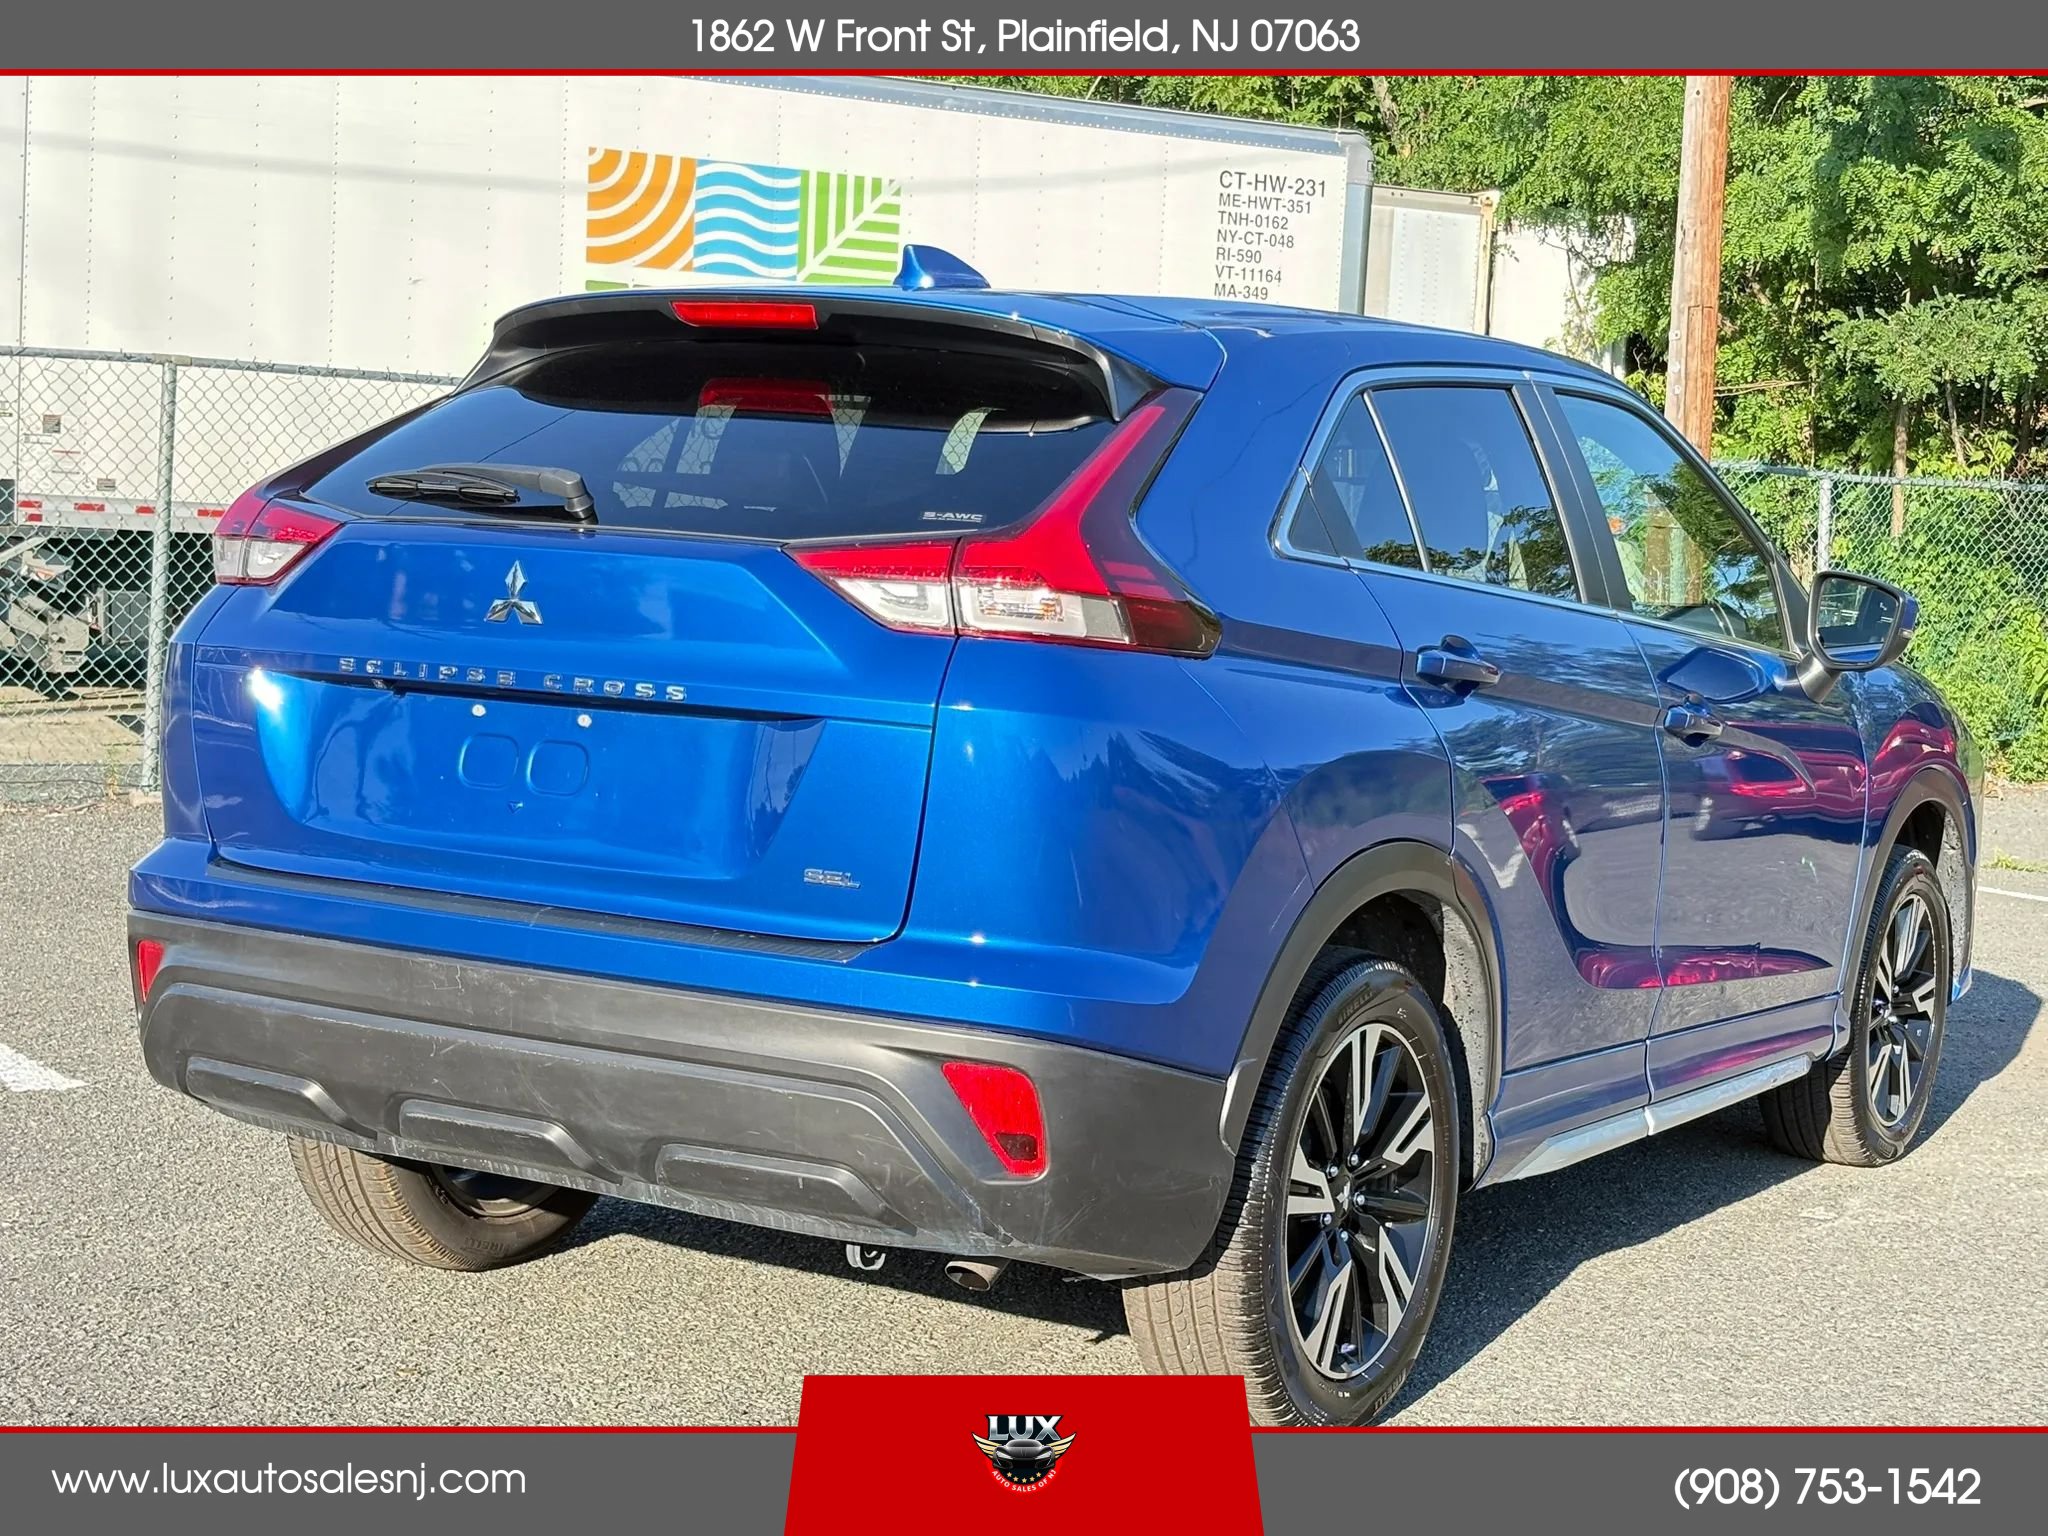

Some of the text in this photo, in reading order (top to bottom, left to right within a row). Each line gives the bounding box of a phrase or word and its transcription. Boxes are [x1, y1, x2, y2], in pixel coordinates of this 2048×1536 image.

[1219, 170, 1326, 198] CT-HW-231
[1218, 193, 1312, 214] ME-HWT-351
[1217, 210, 1289, 230] TNH-0162
[1216, 229, 1295, 249] NY-CT-048
[1215, 247, 1262, 264] RI-590
[1215, 265, 1282, 283] VT-11164
[1213, 283, 1269, 300] MA-349
[338, 657, 688, 702] ECLIPSE CROSS
